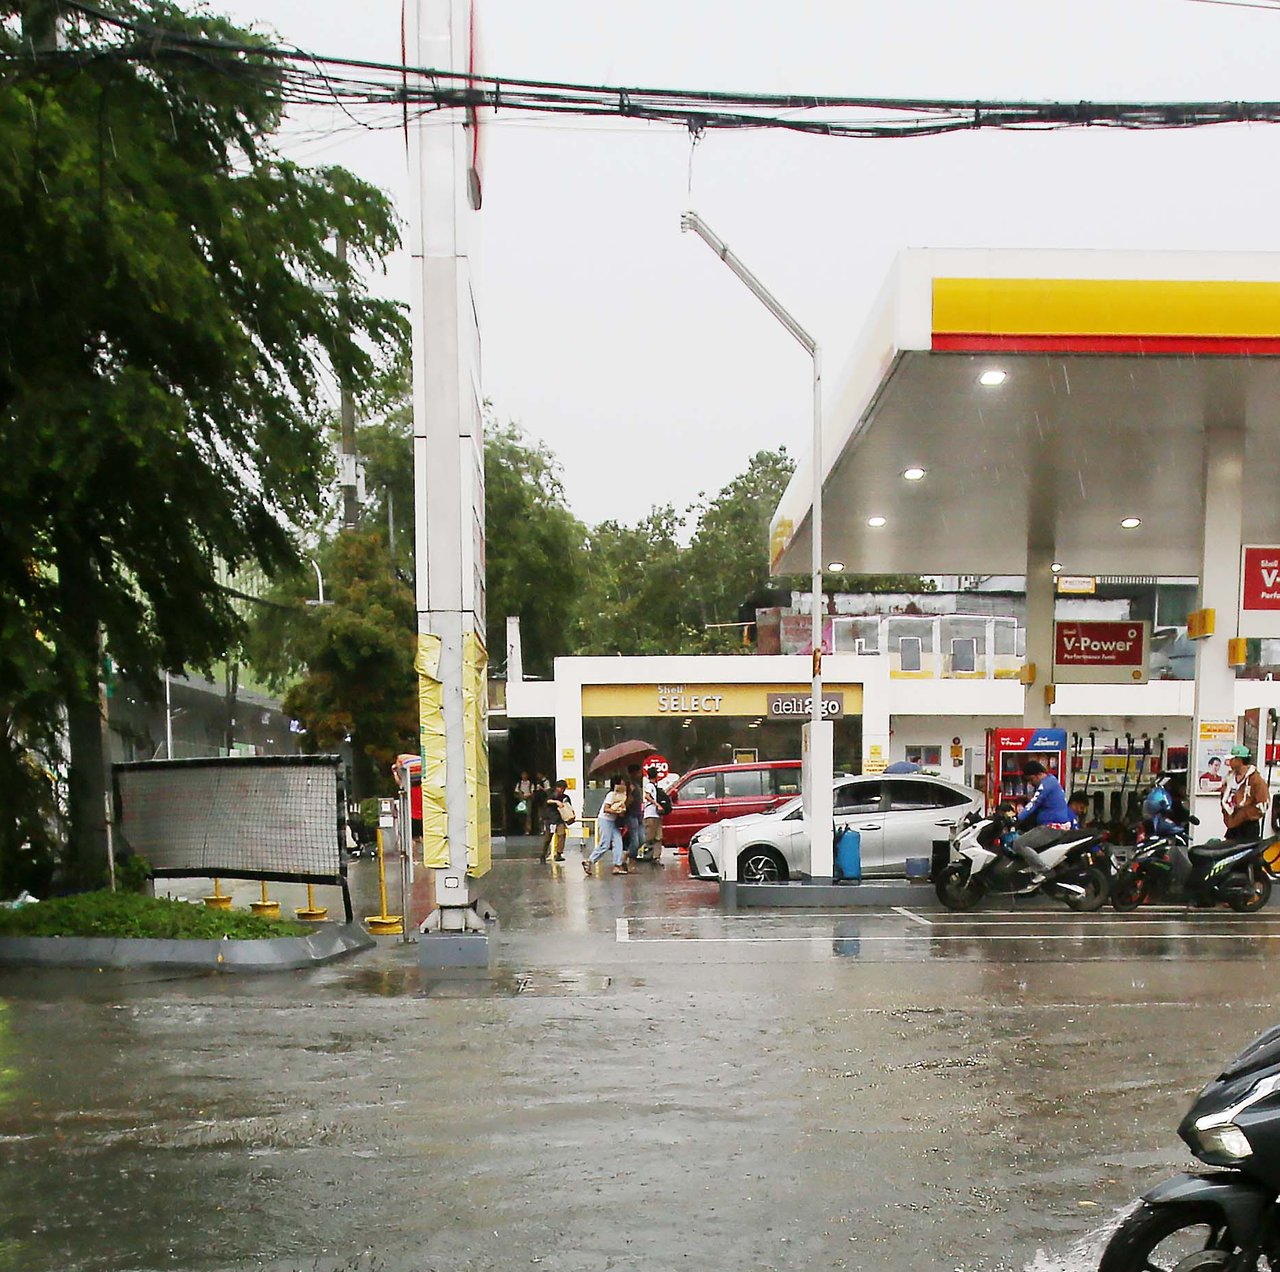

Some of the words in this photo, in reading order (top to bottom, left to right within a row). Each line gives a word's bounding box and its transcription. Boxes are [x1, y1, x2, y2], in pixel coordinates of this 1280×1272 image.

[1063, 636, 1133, 652] V-Power
[657, 684, 684, 695] Shell
[657, 694, 724, 713] SELECT
